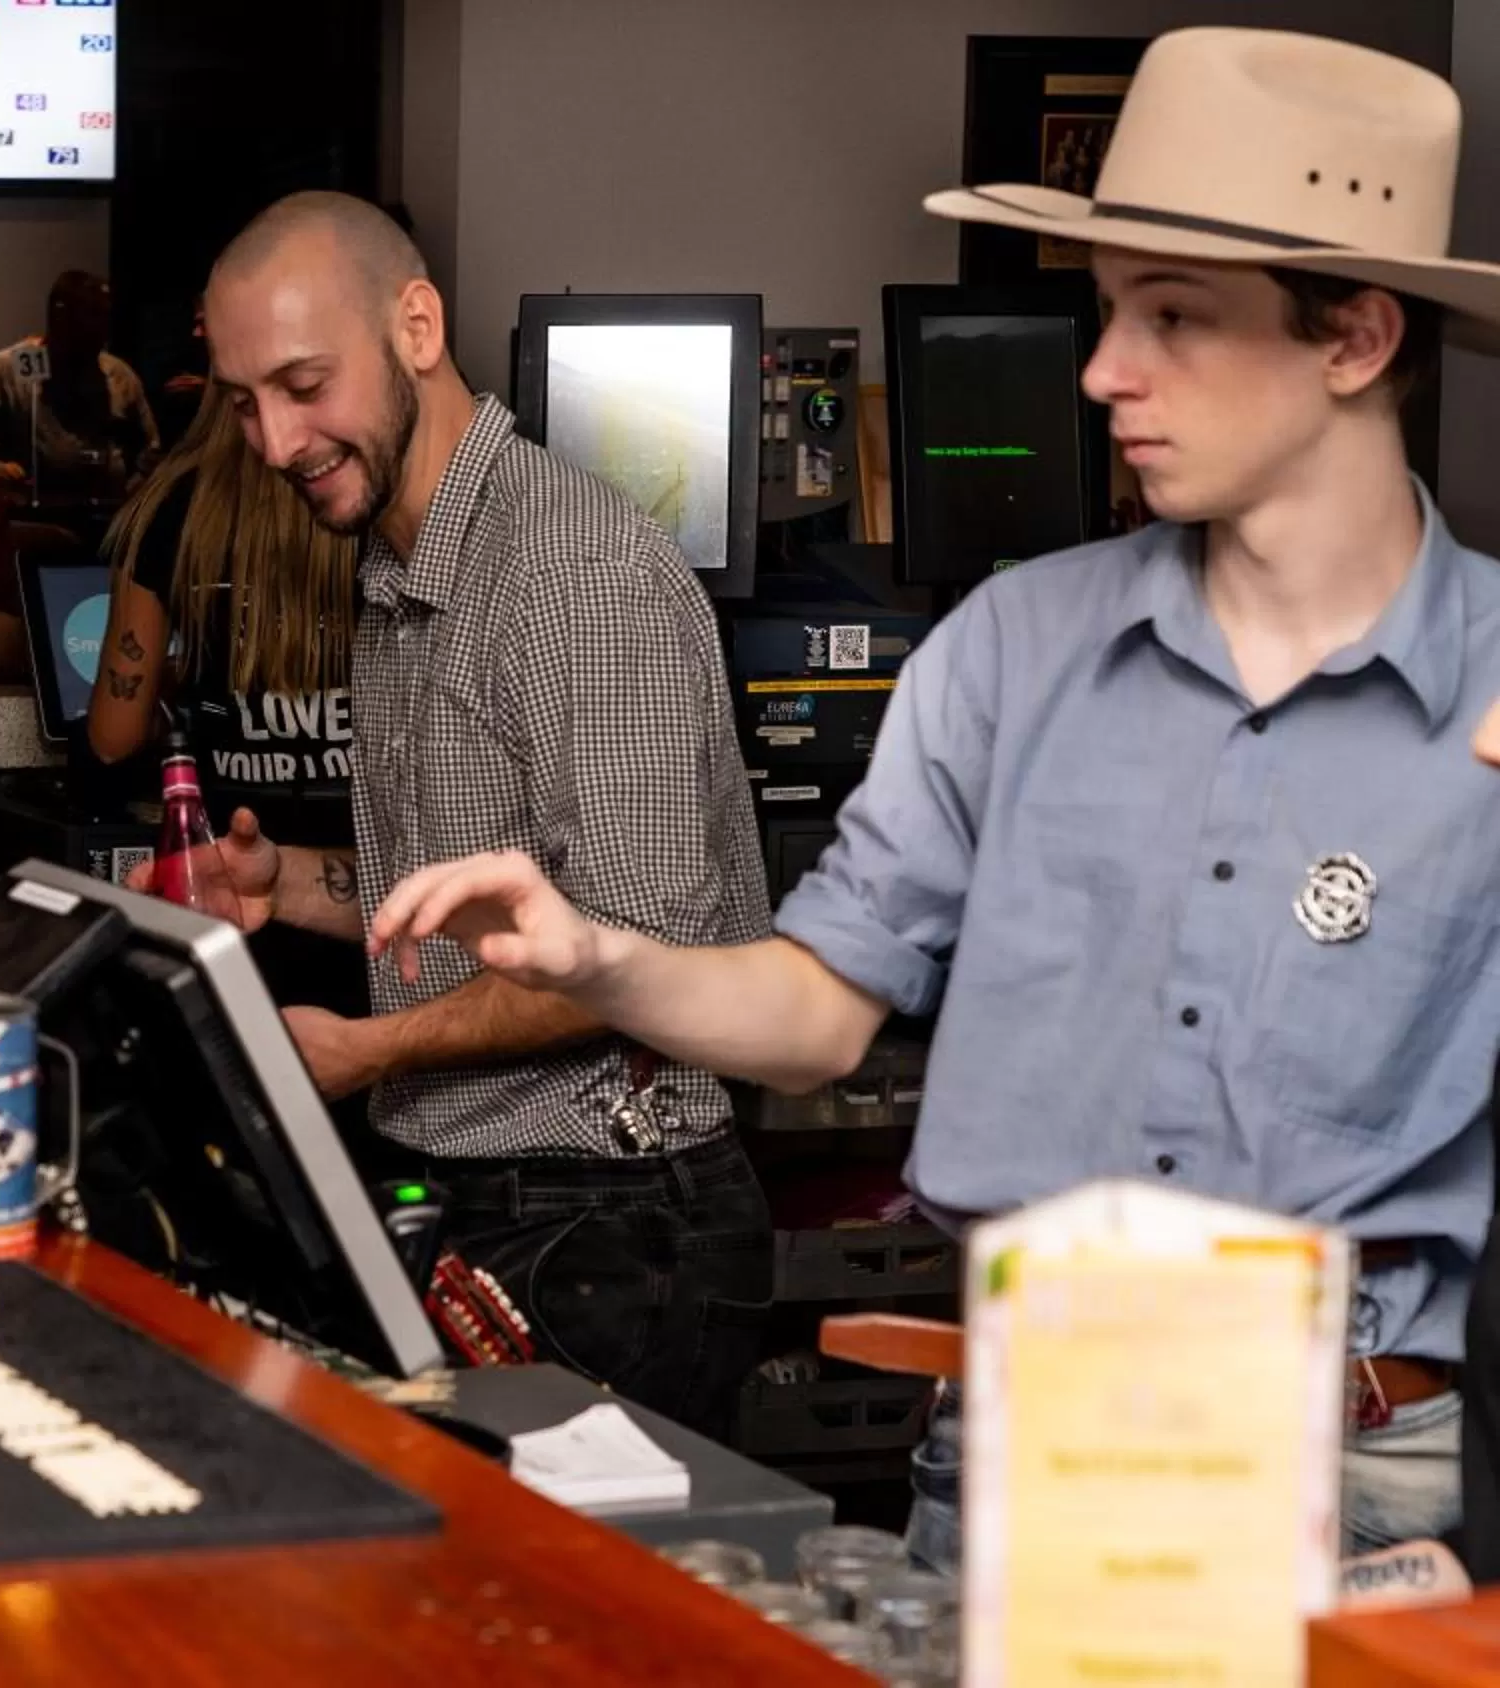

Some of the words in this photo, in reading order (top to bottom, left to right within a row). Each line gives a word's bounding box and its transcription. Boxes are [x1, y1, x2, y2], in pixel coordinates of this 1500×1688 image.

[83, 35, 108, 51] 20
[18, 352, 46, 377] 31
[233, 688, 354, 742] LOVE
